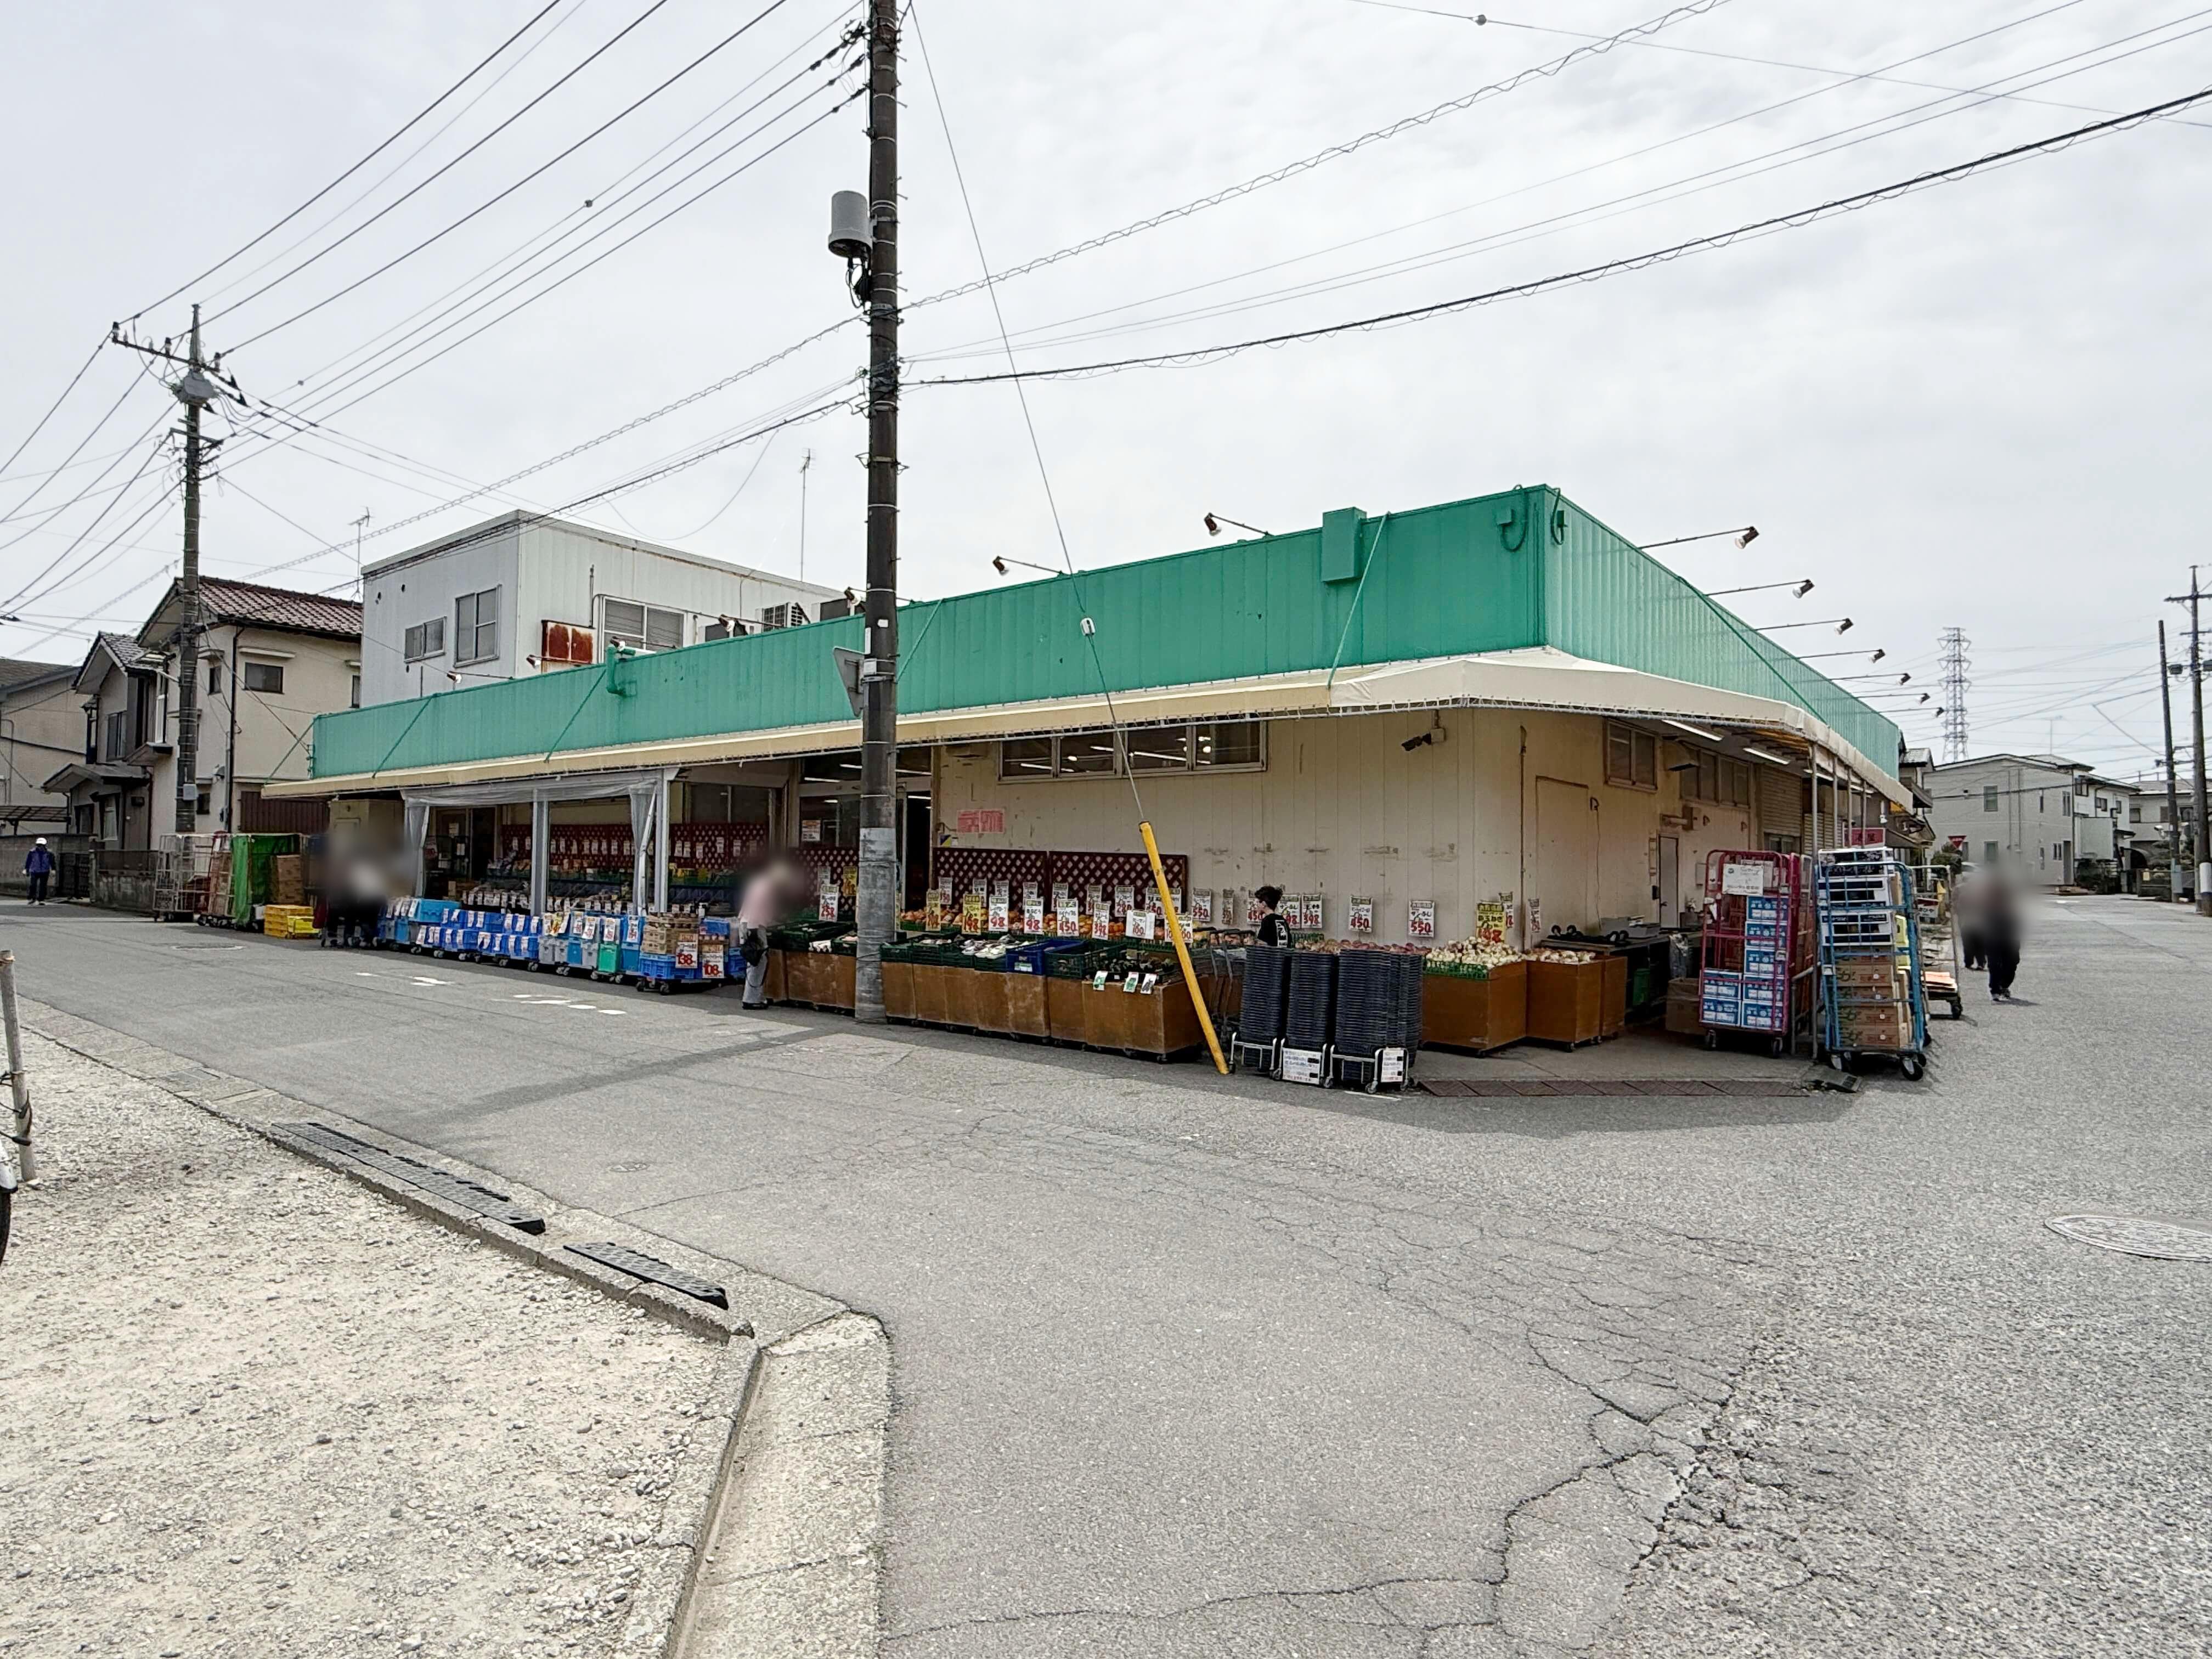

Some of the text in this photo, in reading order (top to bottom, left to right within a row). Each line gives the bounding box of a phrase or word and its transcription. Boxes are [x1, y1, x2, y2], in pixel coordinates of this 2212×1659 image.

[990, 917, 1005, 927] 98
[1026, 919, 1041, 930] 98
[1059, 921, 1076, 932] 450
[1410, 921, 1431, 933] 550
